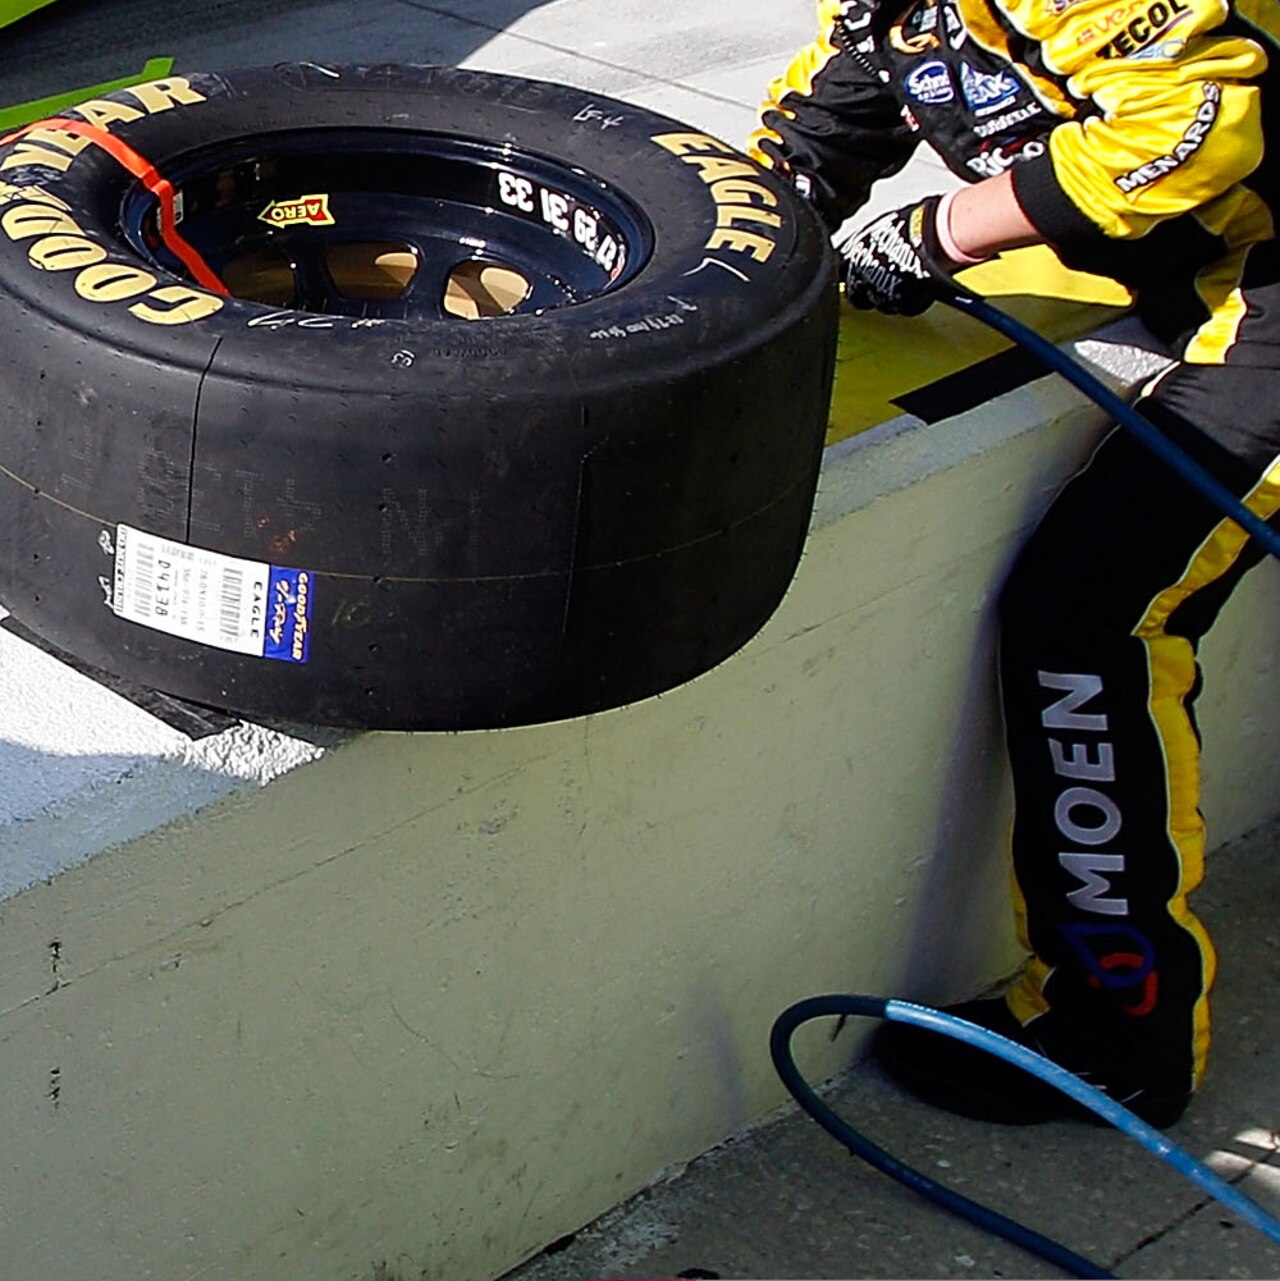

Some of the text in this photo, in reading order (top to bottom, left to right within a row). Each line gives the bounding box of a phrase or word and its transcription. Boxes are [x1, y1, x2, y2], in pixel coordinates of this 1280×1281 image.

[1115, 81, 1222, 193] MENARDS
[271, 202, 322, 221] AERO
[497, 172, 535, 214] 33
[650, 131, 783, 264] EAGLE
[250, 580, 264, 639] EAGLE
[292, 571, 310, 662] GOODYEAR
[1038, 671, 1129, 917] MOEN
